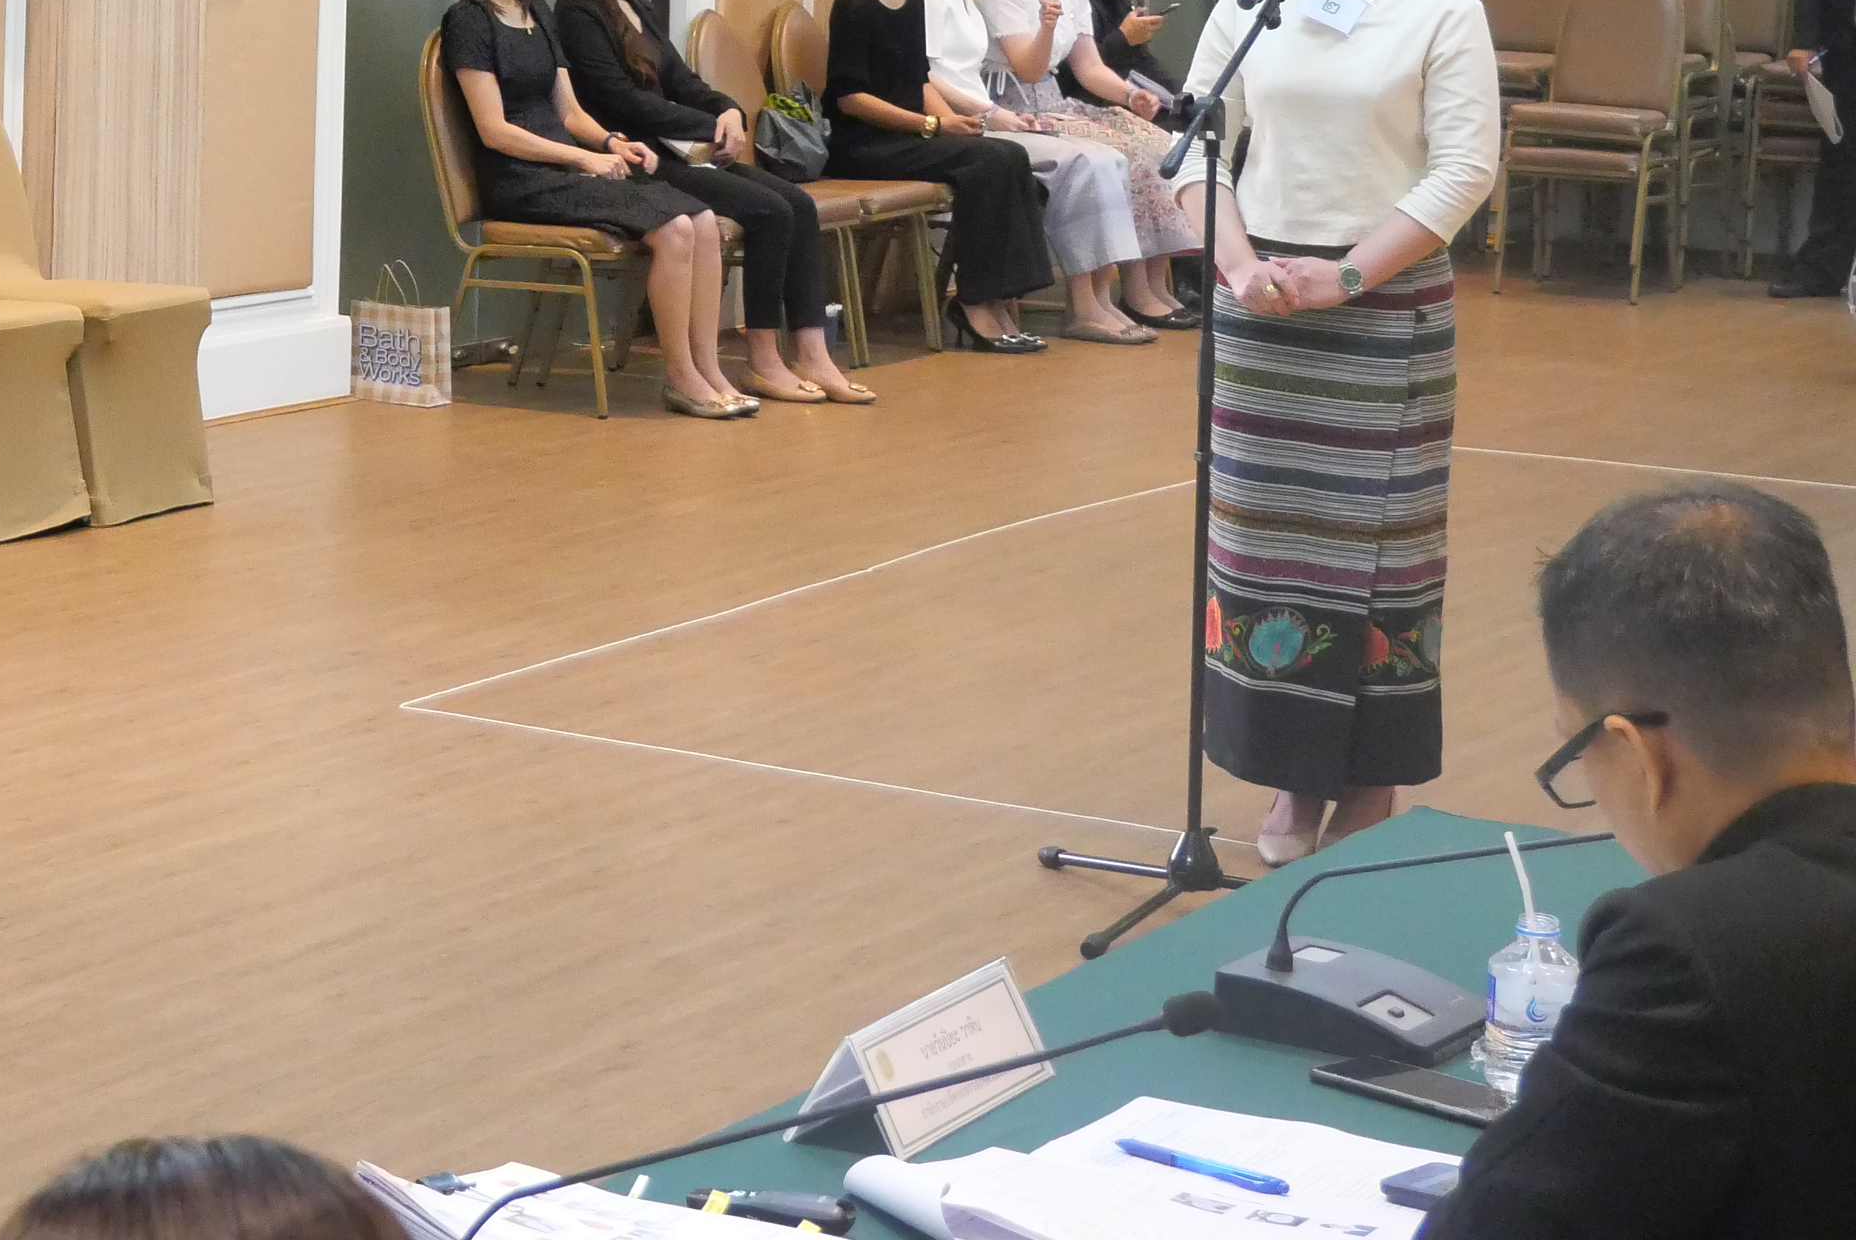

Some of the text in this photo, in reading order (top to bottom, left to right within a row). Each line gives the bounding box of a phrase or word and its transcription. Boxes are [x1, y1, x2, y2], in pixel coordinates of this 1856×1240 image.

[359, 323, 422, 354] Bath
[359, 347, 422, 369] & Body
[359, 362, 422, 387] Works
